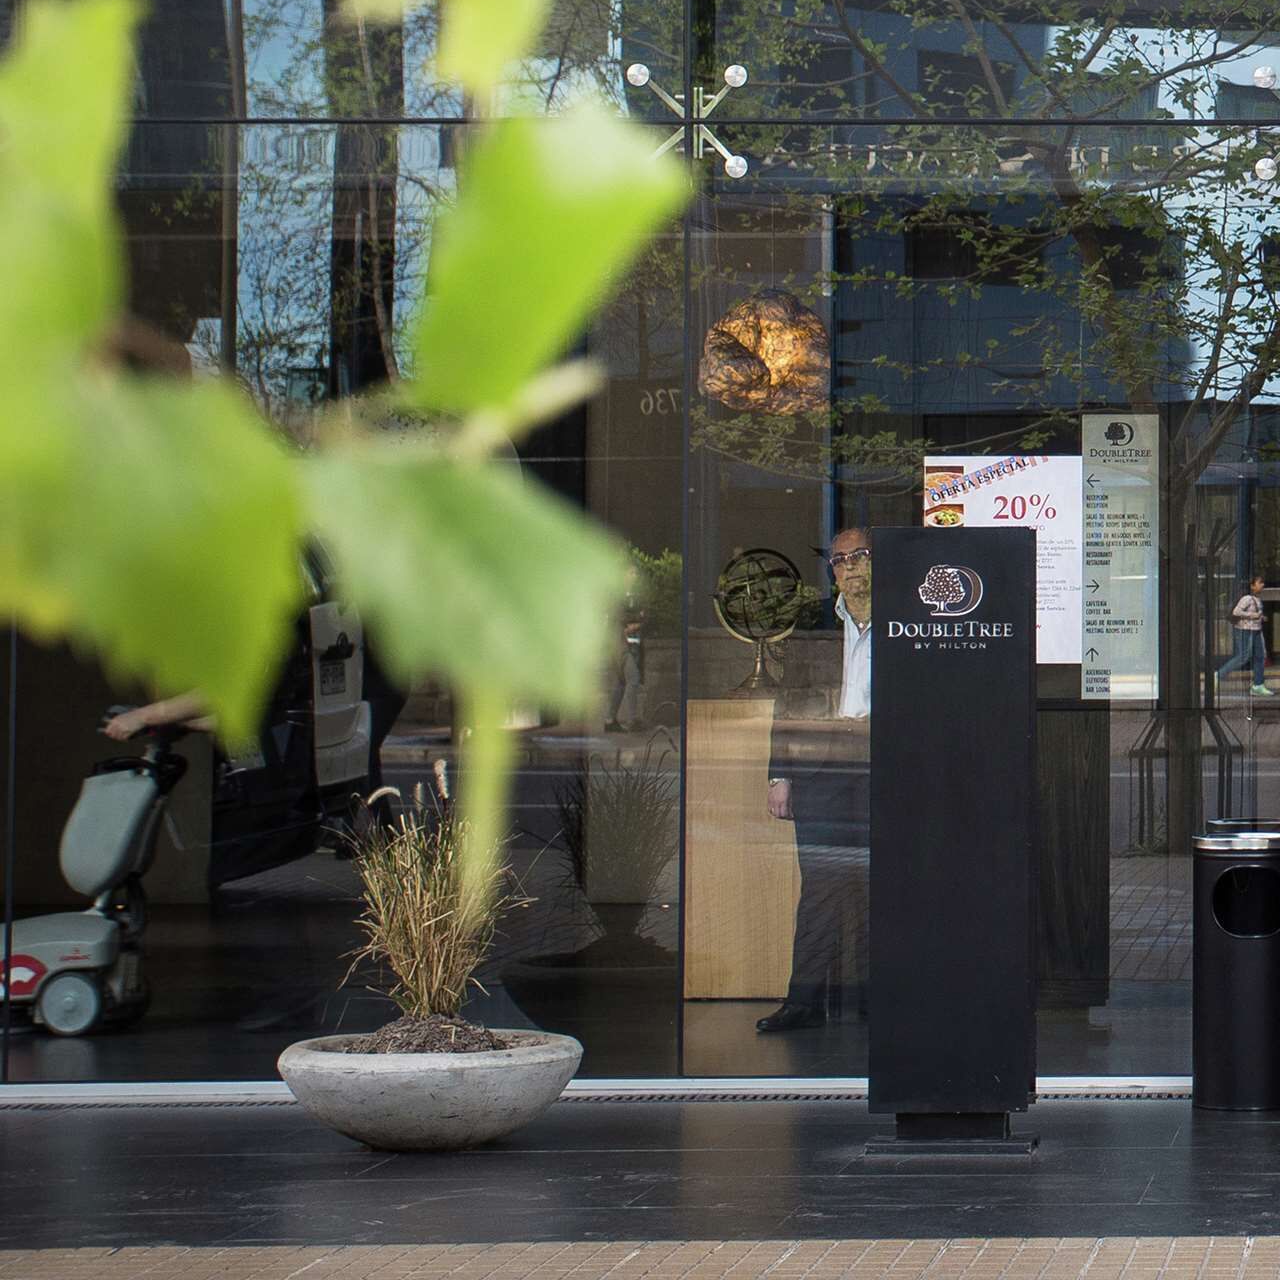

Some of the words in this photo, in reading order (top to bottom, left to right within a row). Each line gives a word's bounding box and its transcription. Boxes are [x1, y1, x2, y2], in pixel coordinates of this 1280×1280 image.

[1090, 448, 1152, 458] DOUBLETREE
[931, 477, 975, 502] OFERTA
[977, 457, 1029, 484] ESPECIAL
[993, 494, 1057, 520] 20%
[887, 621, 1014, 638] DOUBLETREE
[914, 642, 931, 650] BY
[939, 642, 987, 650] HILTON
